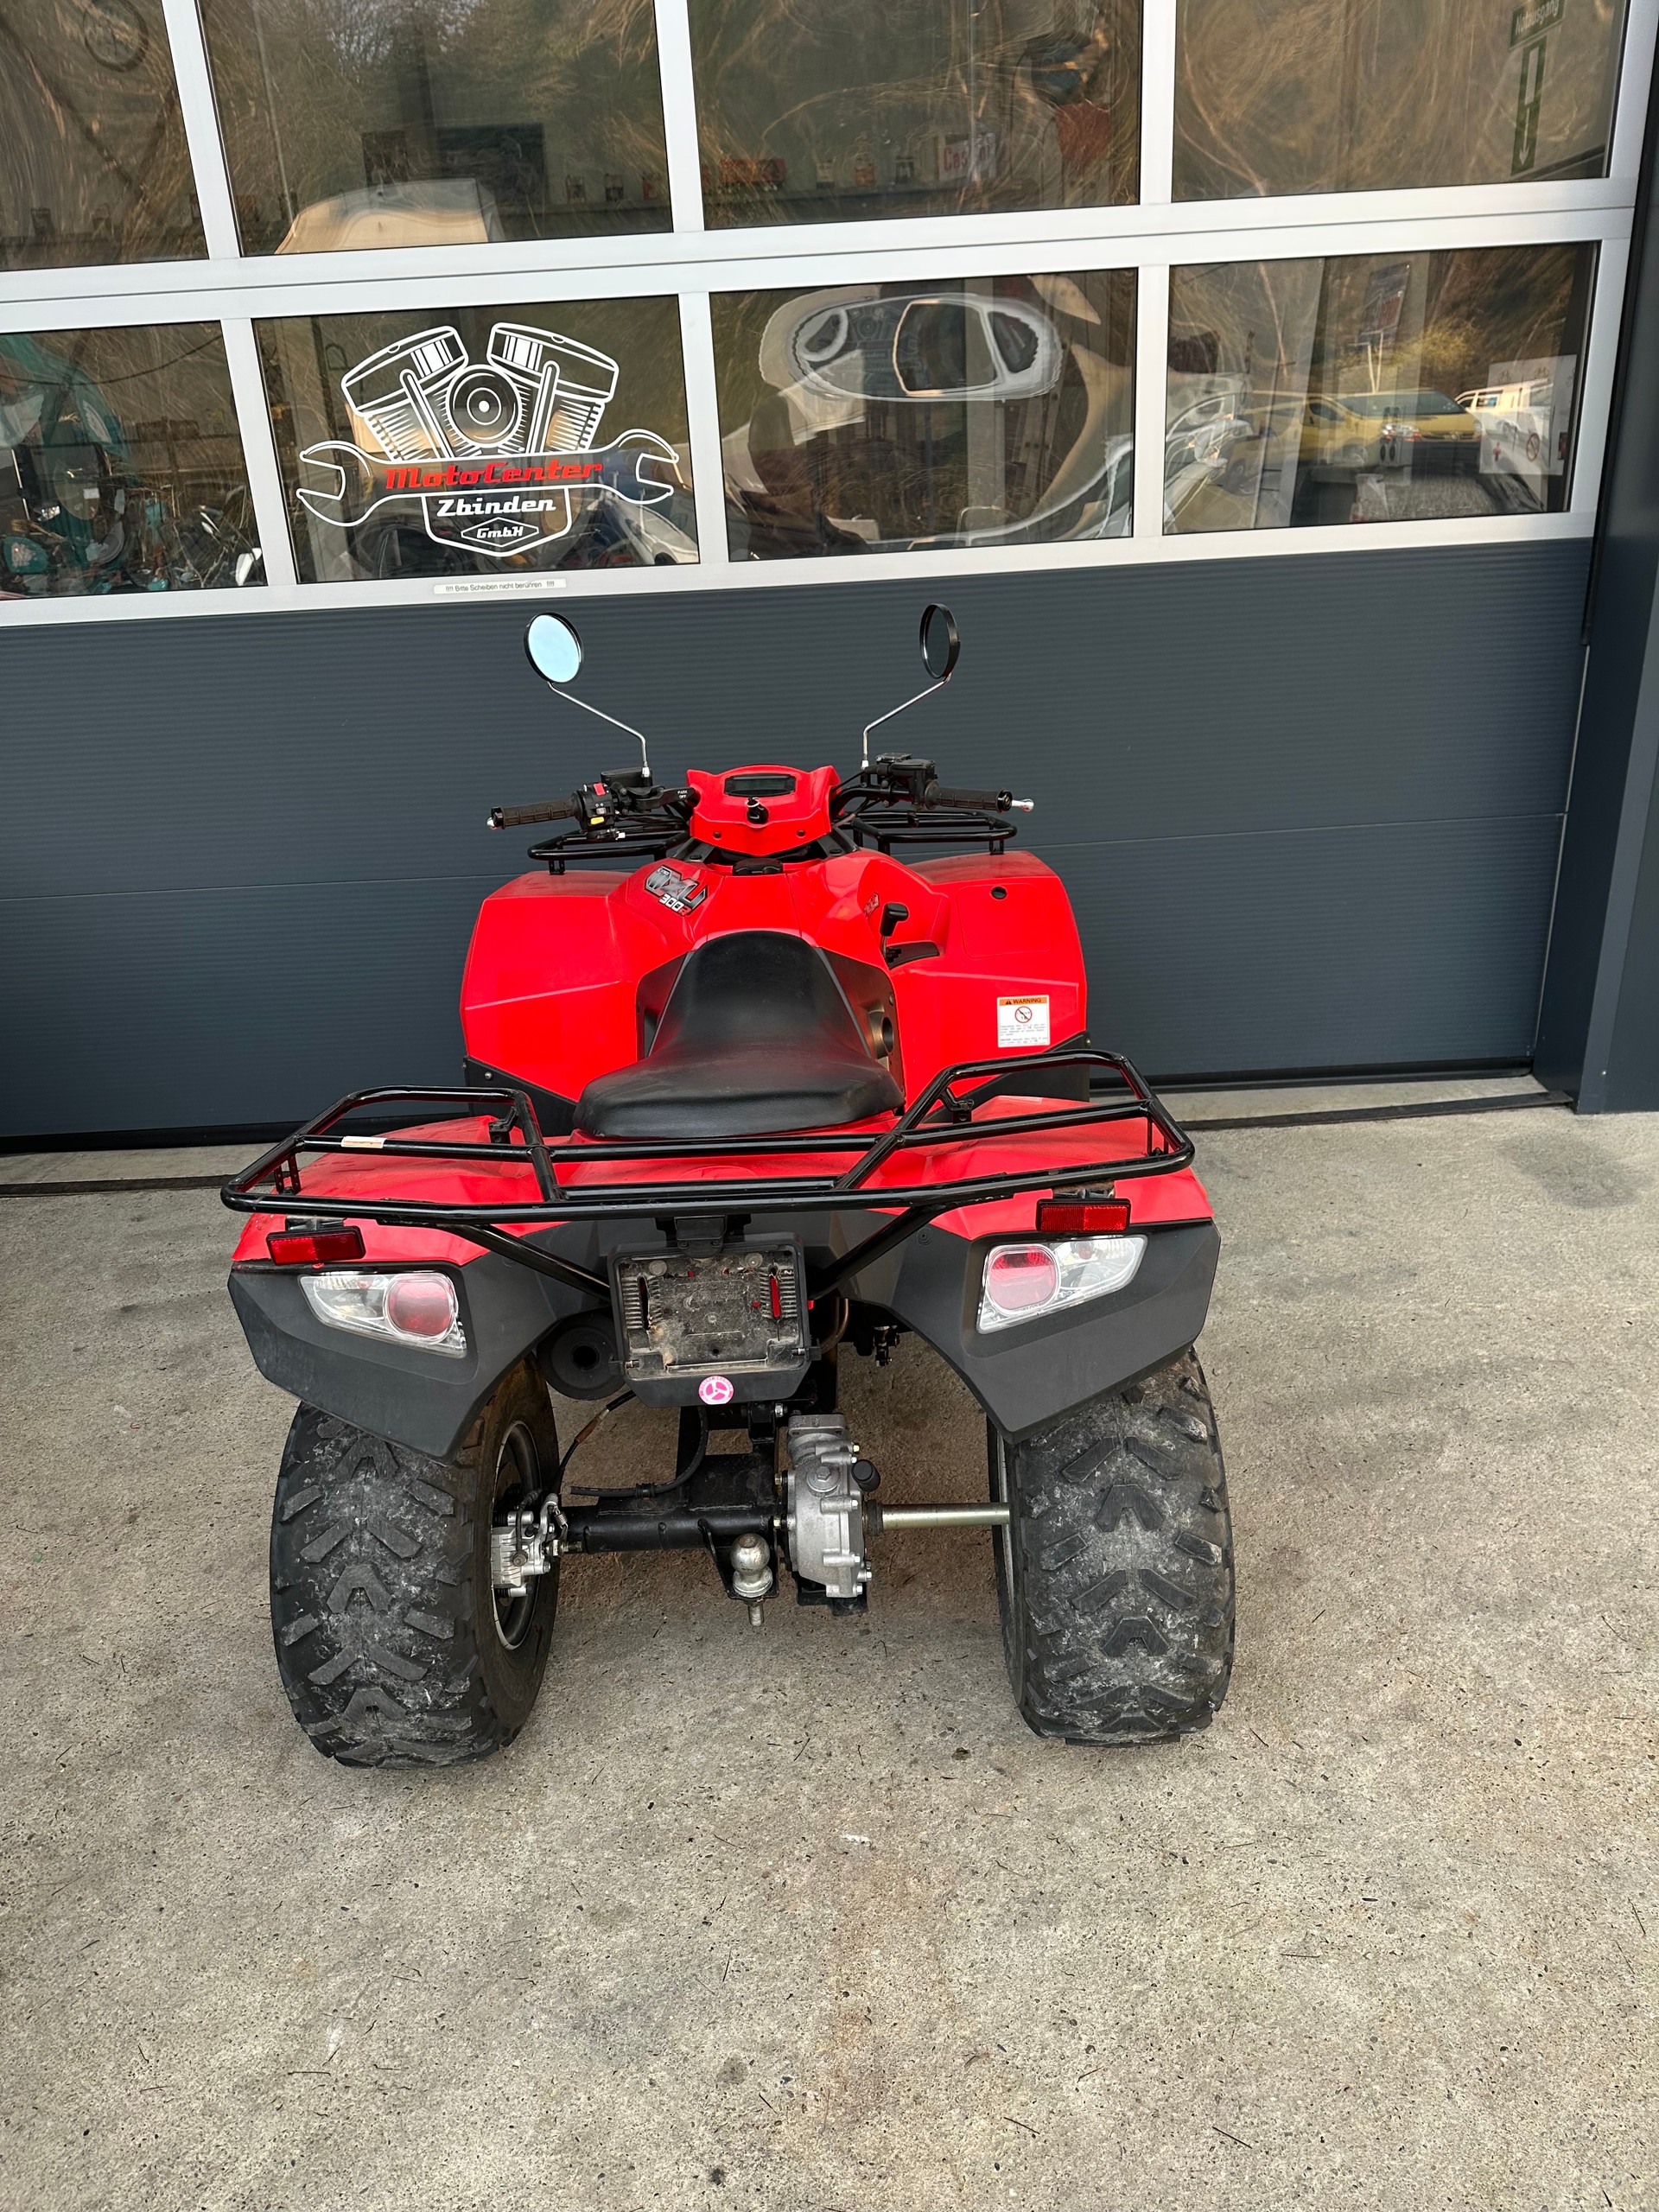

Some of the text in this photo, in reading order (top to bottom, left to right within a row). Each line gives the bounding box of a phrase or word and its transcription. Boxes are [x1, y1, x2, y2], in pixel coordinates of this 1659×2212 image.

[383, 459, 603, 489] MotoCenter
[436, 496, 556, 517] Zbinden
[476, 525, 524, 539] GmbH
